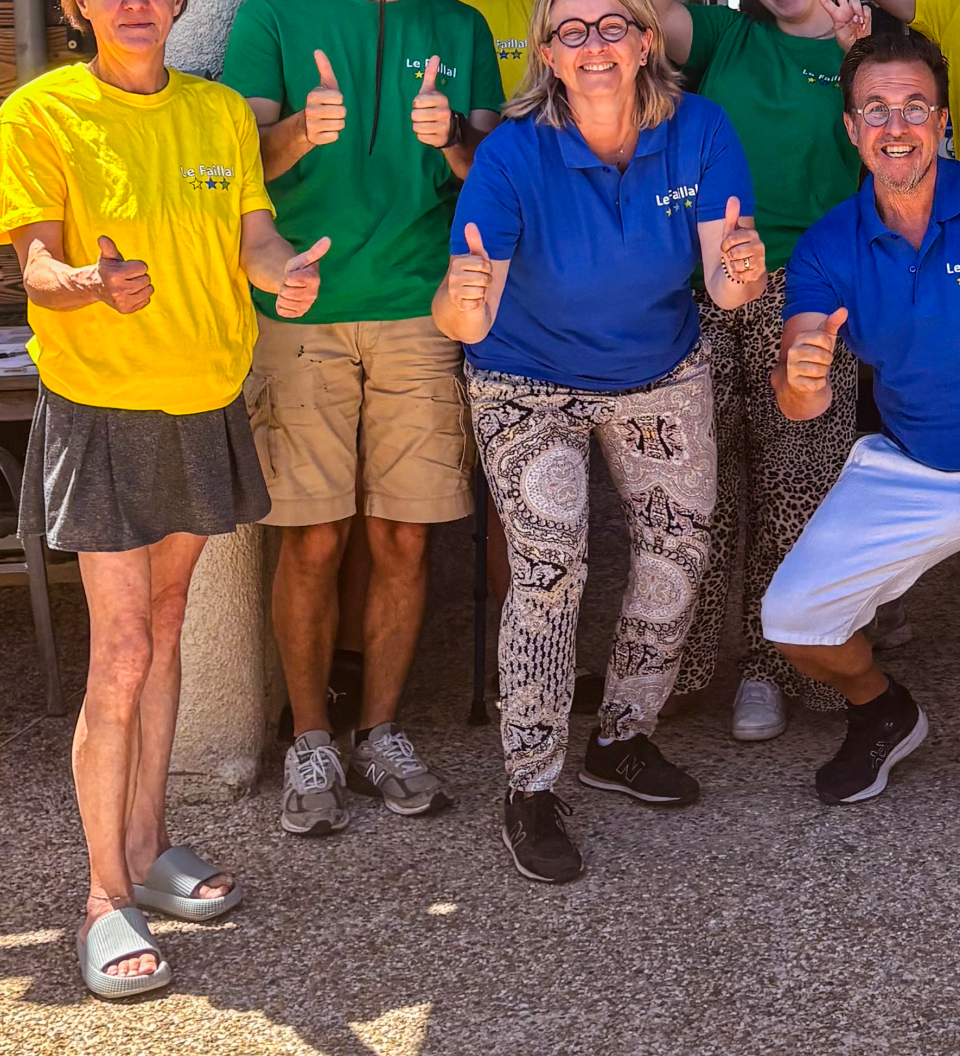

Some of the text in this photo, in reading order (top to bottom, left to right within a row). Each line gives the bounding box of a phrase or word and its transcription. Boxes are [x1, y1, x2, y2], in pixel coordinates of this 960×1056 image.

[406, 58, 457, 78] Le Fillal
[818, 74, 841, 82] Faill
[180, 165, 235, 178] Le Faillal
[656, 194, 670, 206] Le
